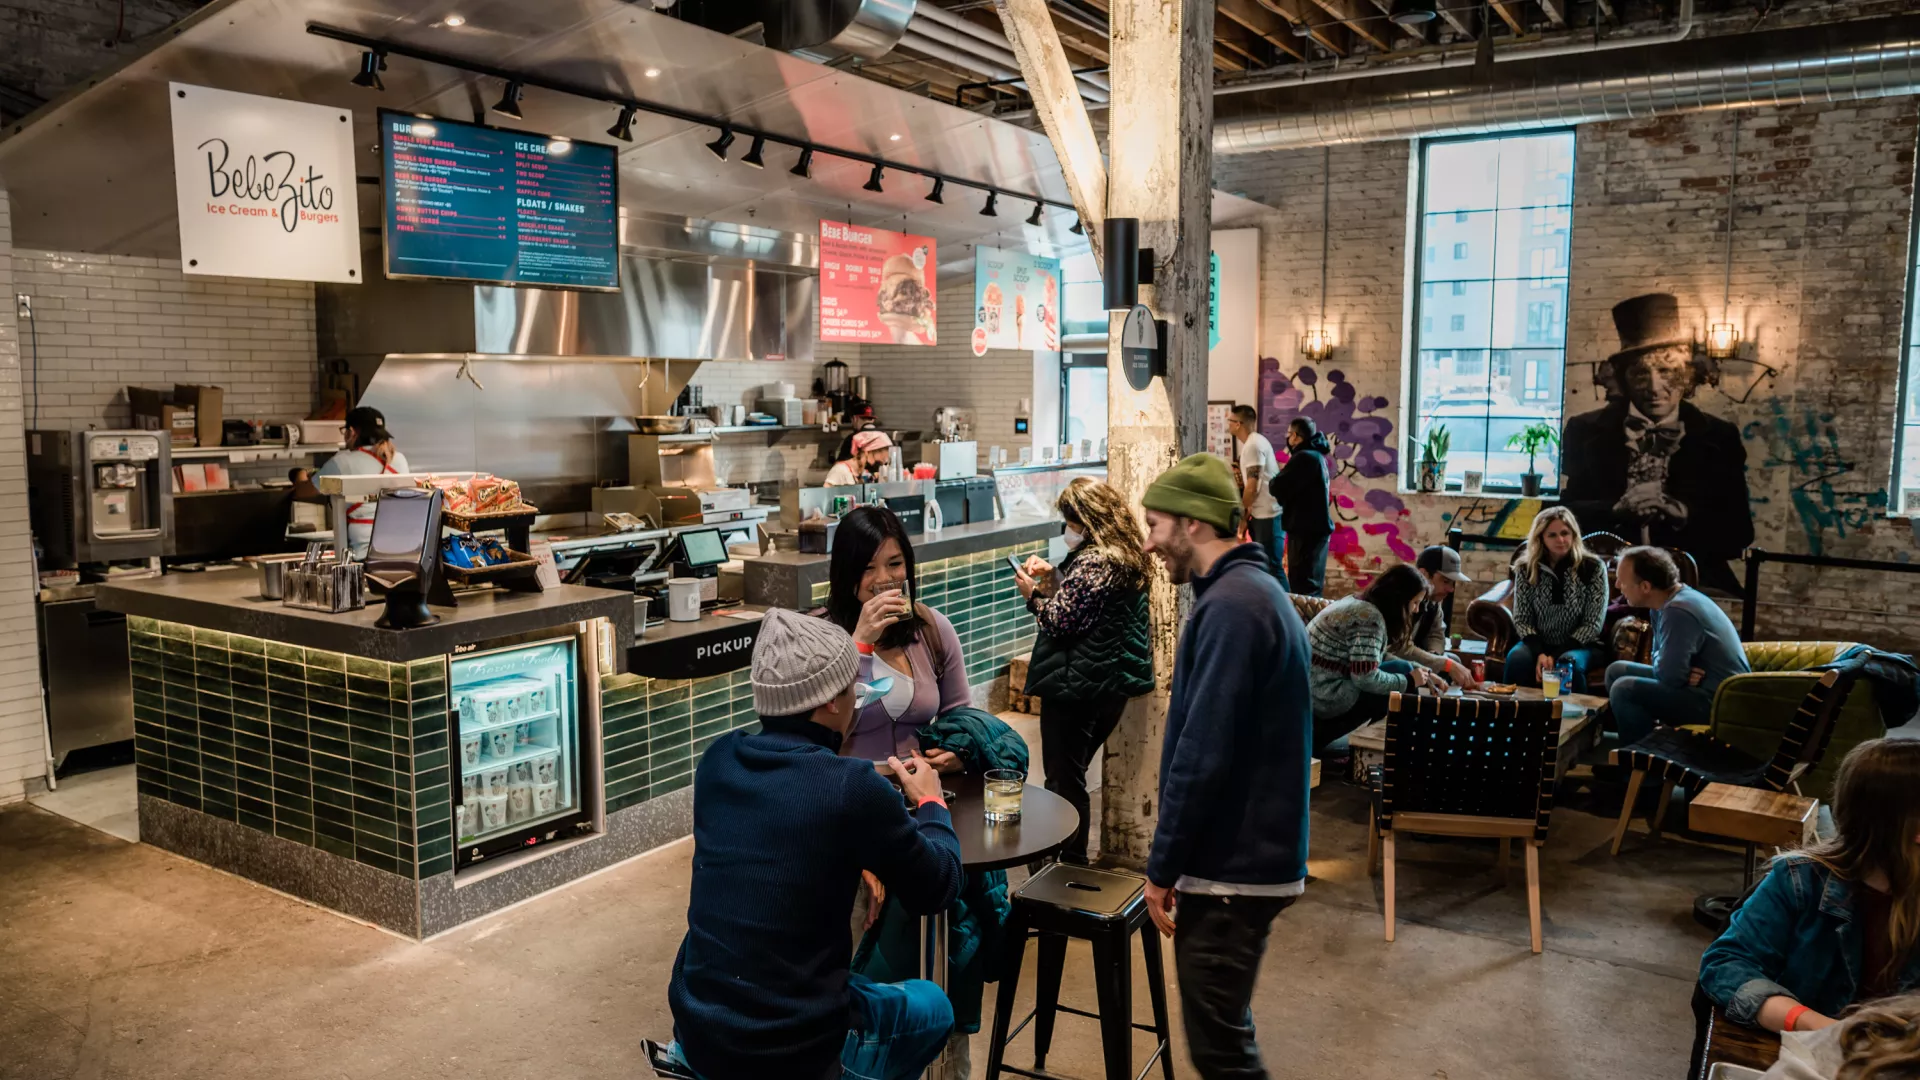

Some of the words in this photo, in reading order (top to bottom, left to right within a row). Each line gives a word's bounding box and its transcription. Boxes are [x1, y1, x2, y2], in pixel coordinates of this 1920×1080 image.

[432, 140, 455, 148] BURGER
[515, 142, 528, 151] ICE
[207, 203, 226, 215] Ice
[229, 204, 268, 217] Cream
[271, 208, 278, 218] &
[300, 211, 339, 224] Burgers
[517, 198, 546, 209] FLOATS
[549, 202, 553, 211] /
[555, 202, 585, 214] SHAKES
[842, 226, 872, 244] BURGER
[697, 636, 752, 659] PICKUP
[466, 662, 516, 677] Frozen
[522, 647, 560, 668] Foods
